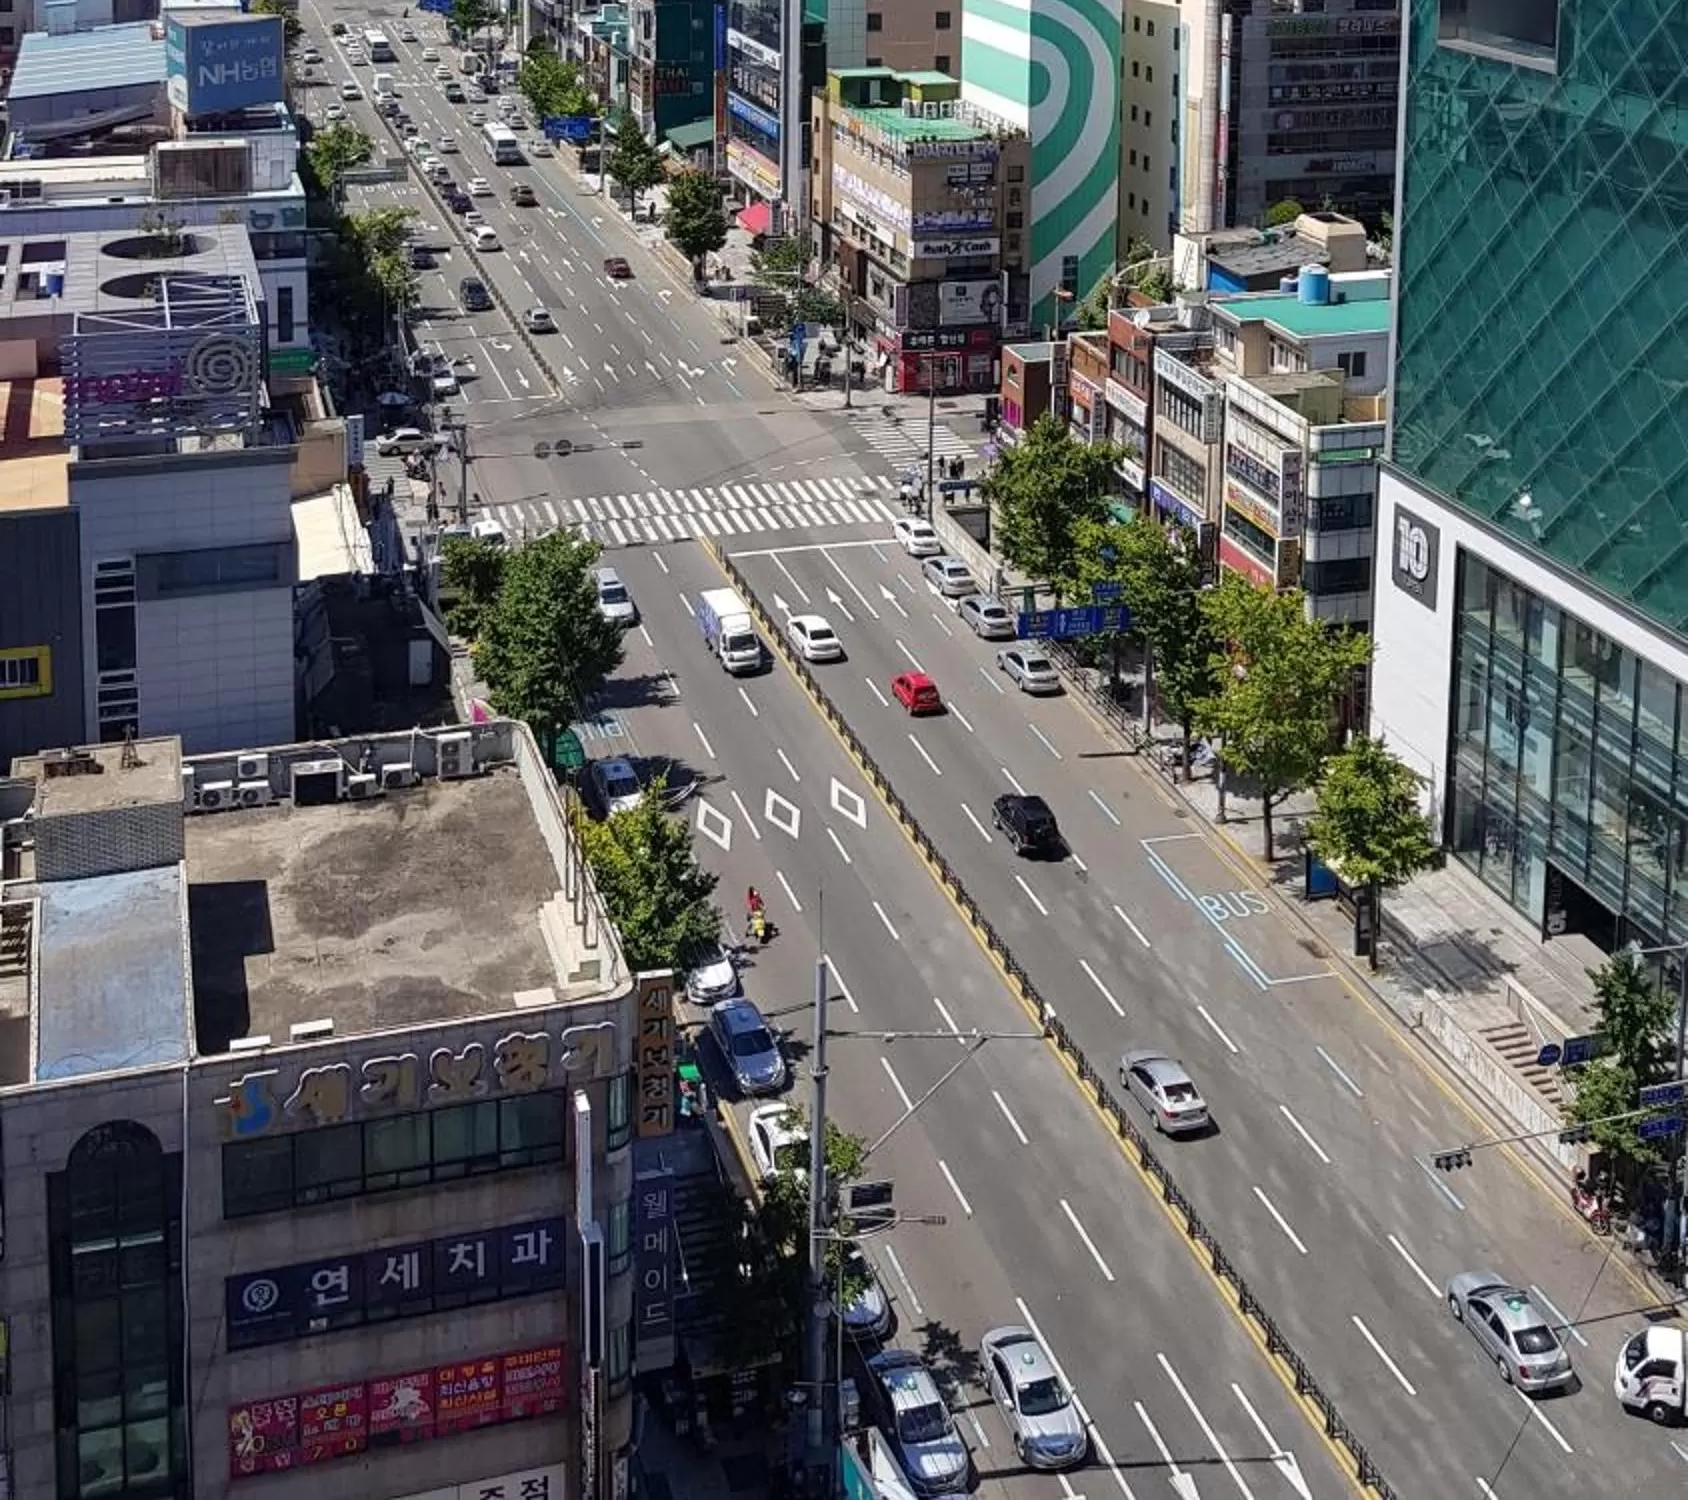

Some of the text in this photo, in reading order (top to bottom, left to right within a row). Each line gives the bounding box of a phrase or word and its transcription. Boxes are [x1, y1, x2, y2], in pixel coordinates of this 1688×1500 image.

[1397, 514, 1430, 580] 10
[1199, 891, 1269, 921] BUS
[310, 1228, 552, 1308] 연세치과
